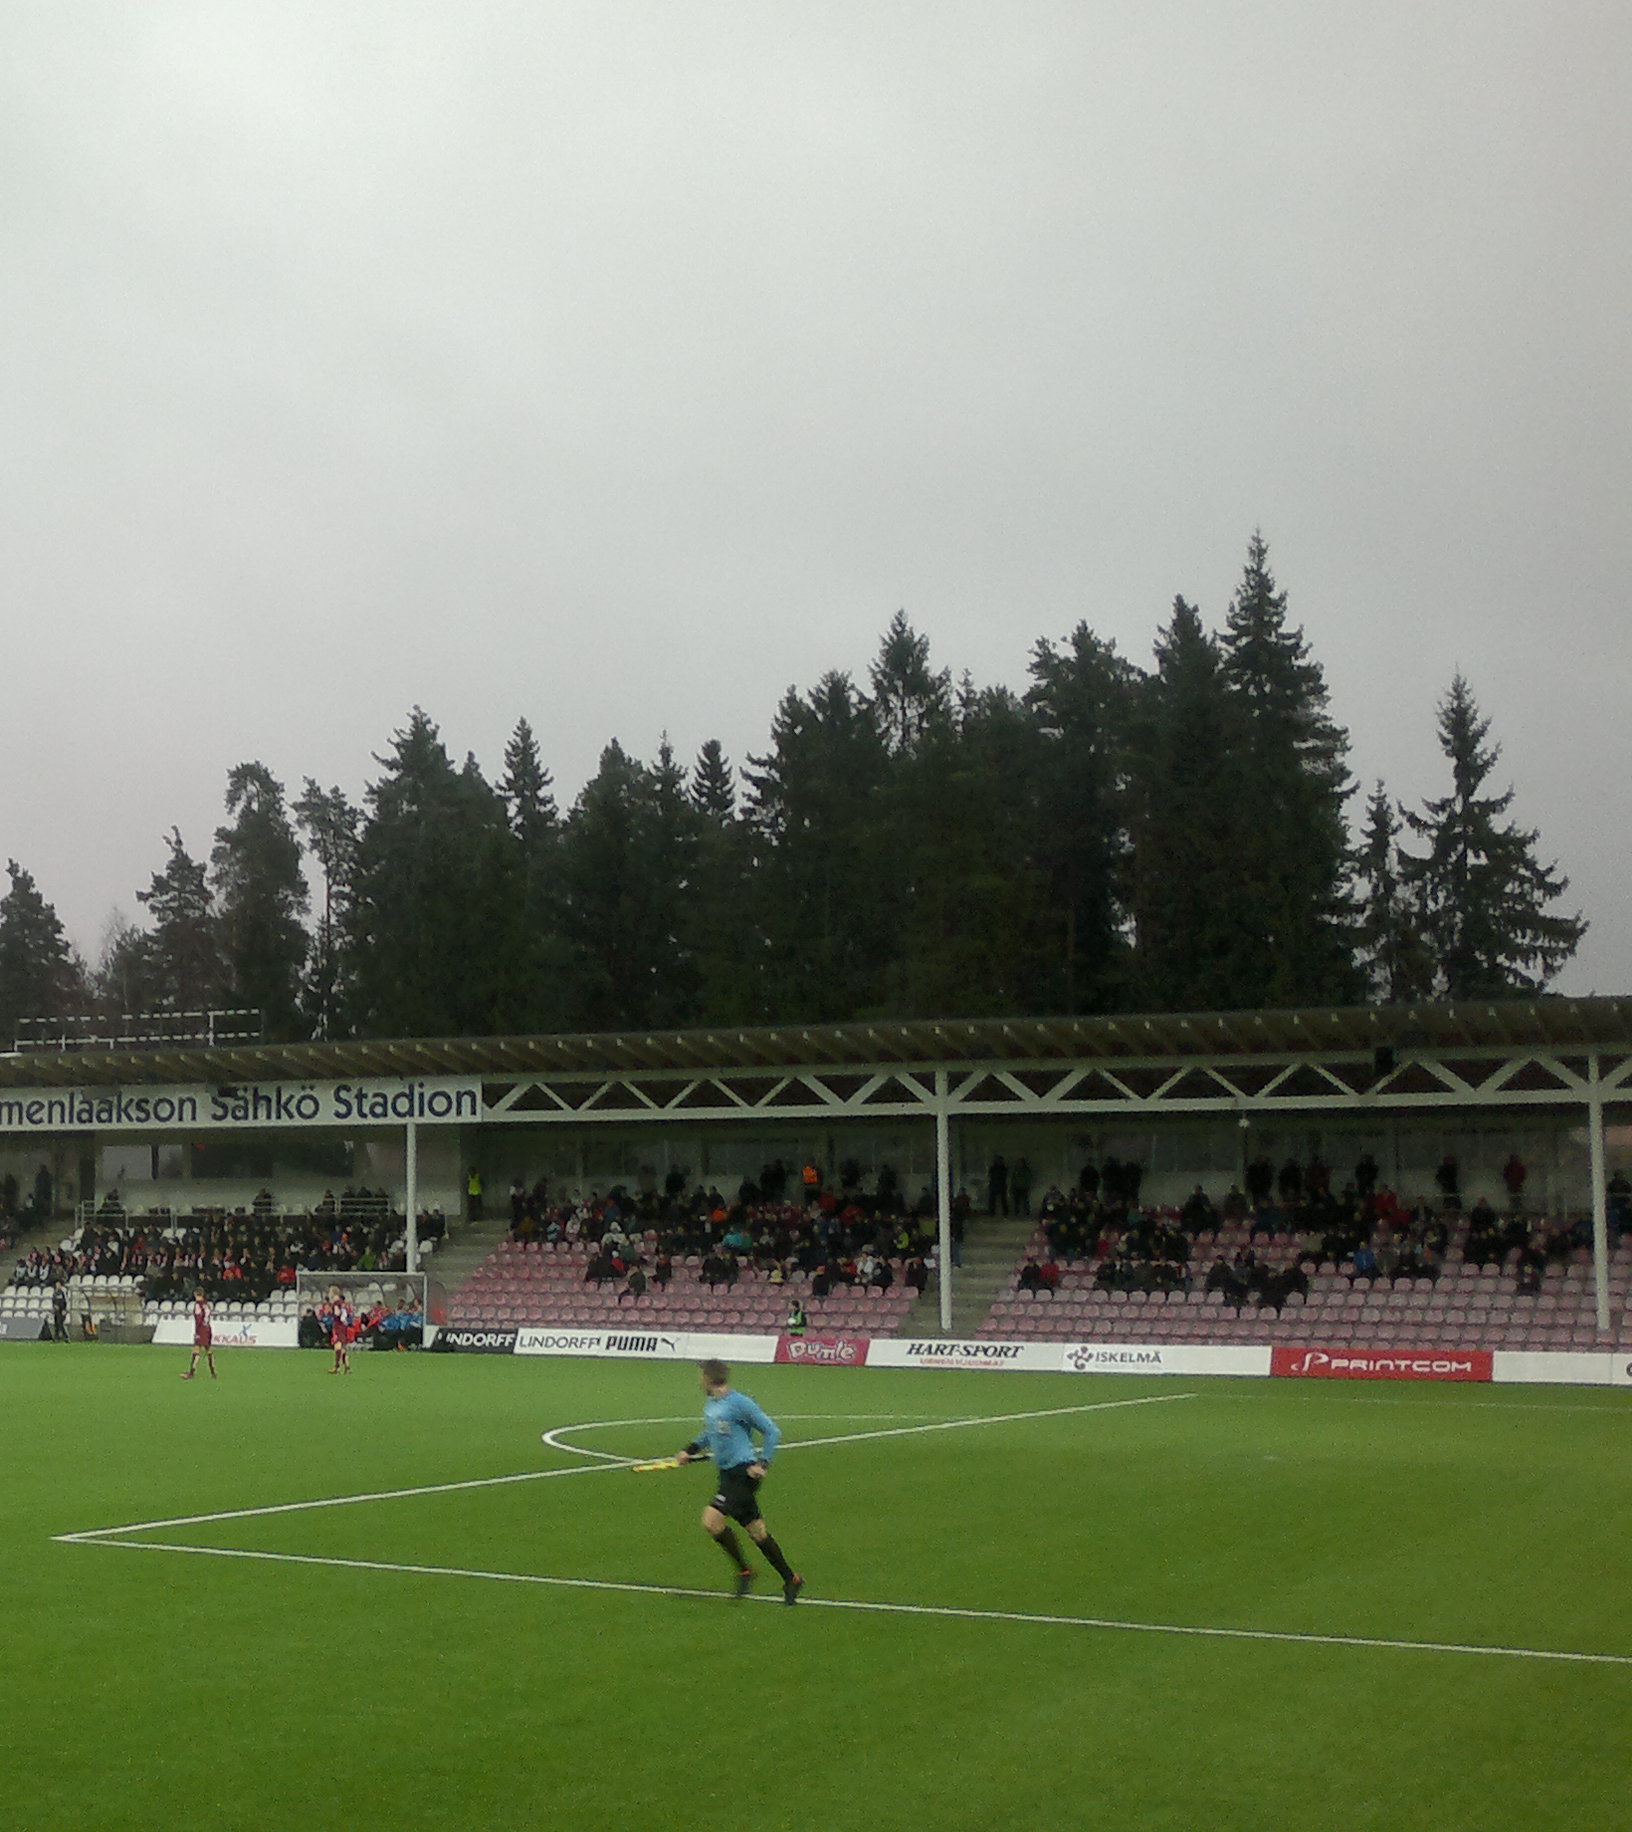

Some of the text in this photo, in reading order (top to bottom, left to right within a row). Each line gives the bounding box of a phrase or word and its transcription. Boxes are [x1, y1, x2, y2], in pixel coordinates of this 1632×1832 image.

[211, 1085, 320, 1121] Sähkö
[333, 1082, 477, 1119] Stadion
[606, 1335, 658, 1351] PUMA
[787, 1340, 856, 1361] Dumle
[906, 1343, 1024, 1358] HART-SPORT
[1096, 1350, 1162, 1363] ISKELMÄ
[1331, 1359, 1472, 1372] PRINTCOM
